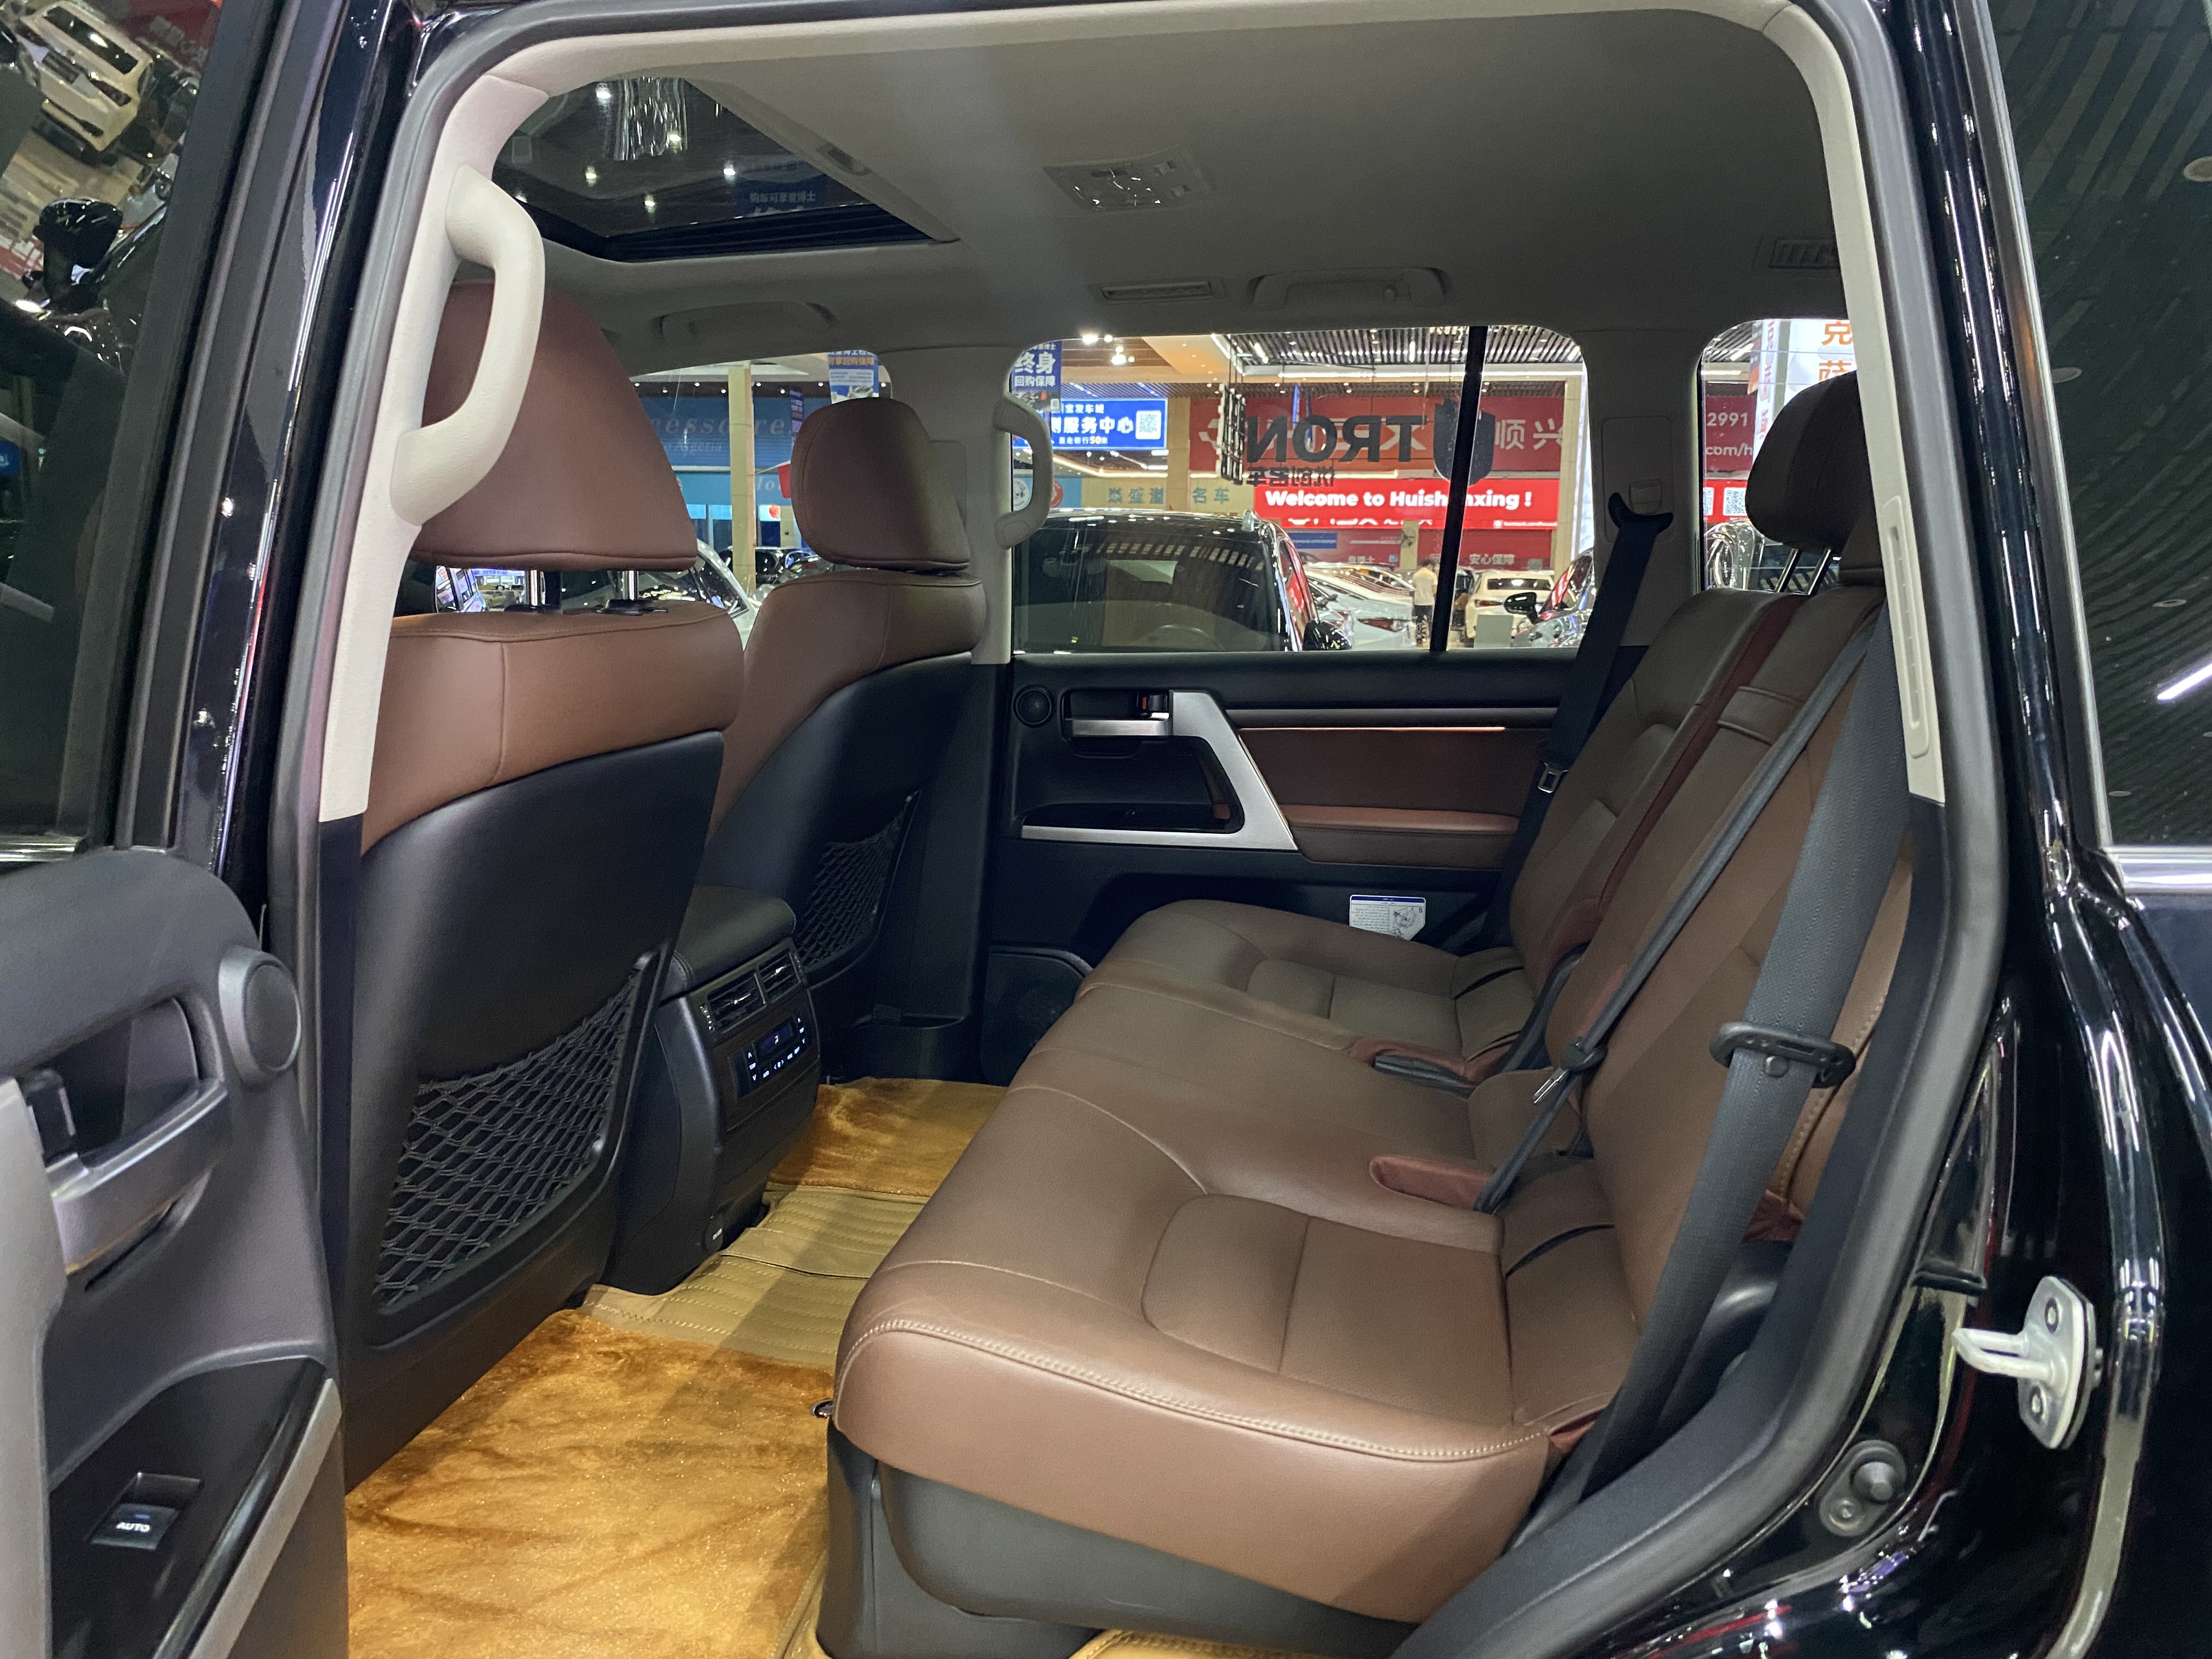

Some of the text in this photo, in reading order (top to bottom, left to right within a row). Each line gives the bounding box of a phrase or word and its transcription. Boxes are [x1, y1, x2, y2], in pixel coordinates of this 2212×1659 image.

[1014, 351, 1056, 374] 终身
[1014, 375, 1056, 386] 回购保障
[1706, 413, 1748, 427] 2991
[1265, 490, 1358, 507] Welcome
[1363, 492, 1385, 507] to
[1390, 489, 1520, 511] Huishnxing
[115, 1521, 150, 1533] AUTO
